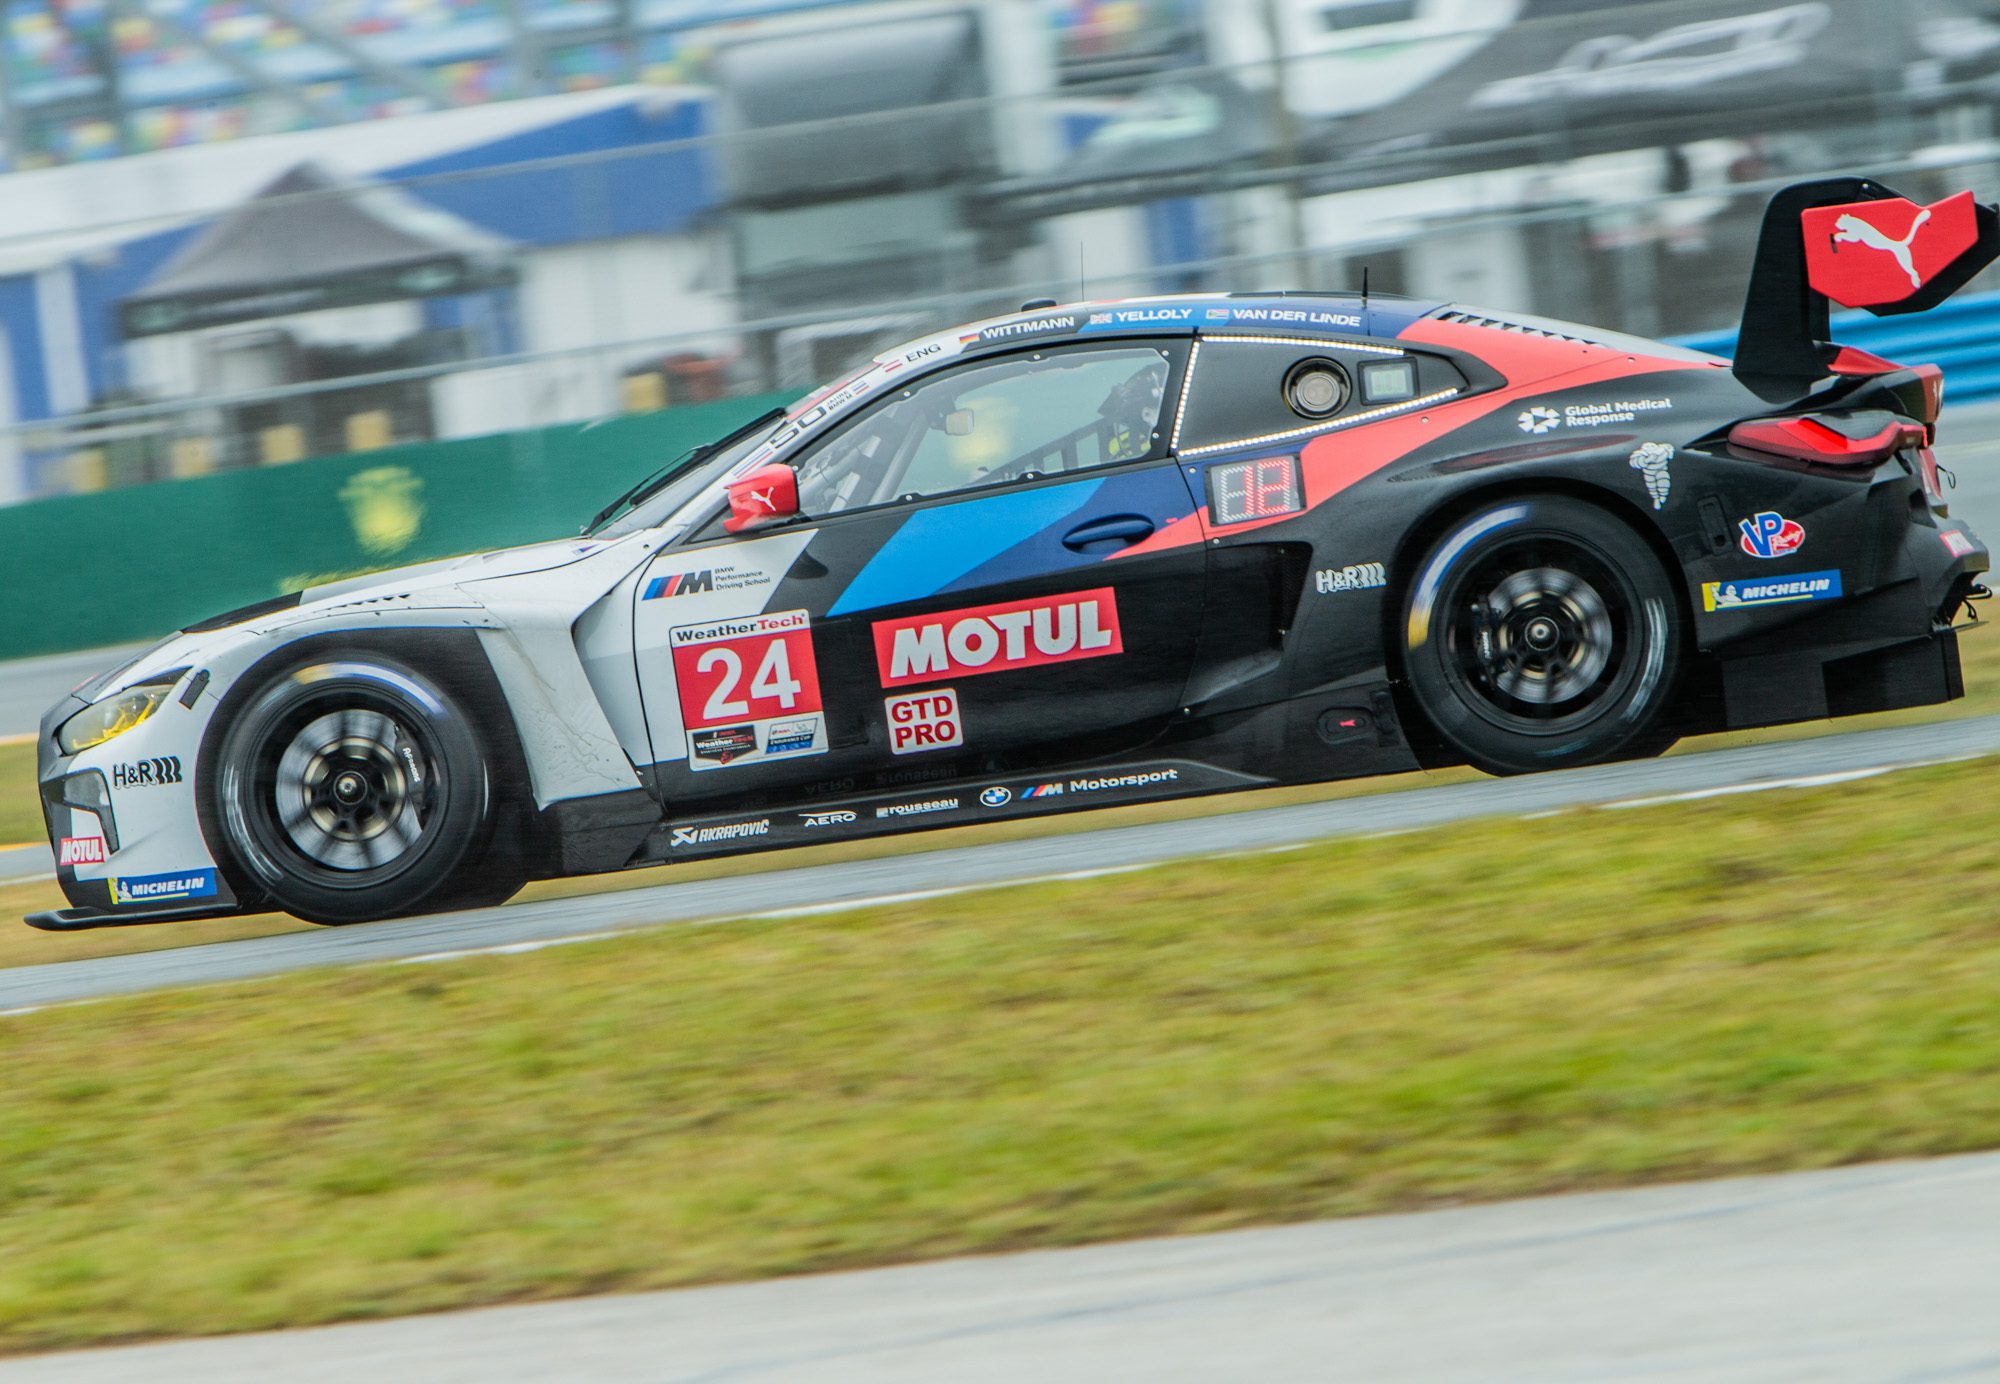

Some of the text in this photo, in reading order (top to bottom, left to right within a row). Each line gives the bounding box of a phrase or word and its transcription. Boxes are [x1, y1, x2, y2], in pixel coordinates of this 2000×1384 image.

[1116, 309, 1193, 321] YELLOLY
[1232, 309, 1361, 327] VAN DER LINDE
[983, 316, 1075, 339] WITTMANN
[905, 344, 942, 362] ENG
[1564, 398, 1672, 417] Global Medical
[770, 406, 827, 449] 50
[1566, 411, 1635, 427] Response
[1738, 511, 1784, 556] VP
[714, 566, 735, 574] BMW
[715, 570, 763, 581] Performance
[716, 577, 771, 591] Driving School
[1742, 579, 1830, 599] MICHELIN
[676, 615, 804, 642] WeatherTech
[889, 600, 1112, 678] MOTUL
[696, 638, 802, 720] 24
[891, 696, 953, 723] GTD
[894, 721, 956, 749] PRO
[1070, 769, 1178, 793] Motorsport
[889, 798, 958, 815] rousseau
[804, 814, 857, 827] AERO
[60, 839, 102, 863] MOTUL
[132, 877, 205, 895] MICHELIN
